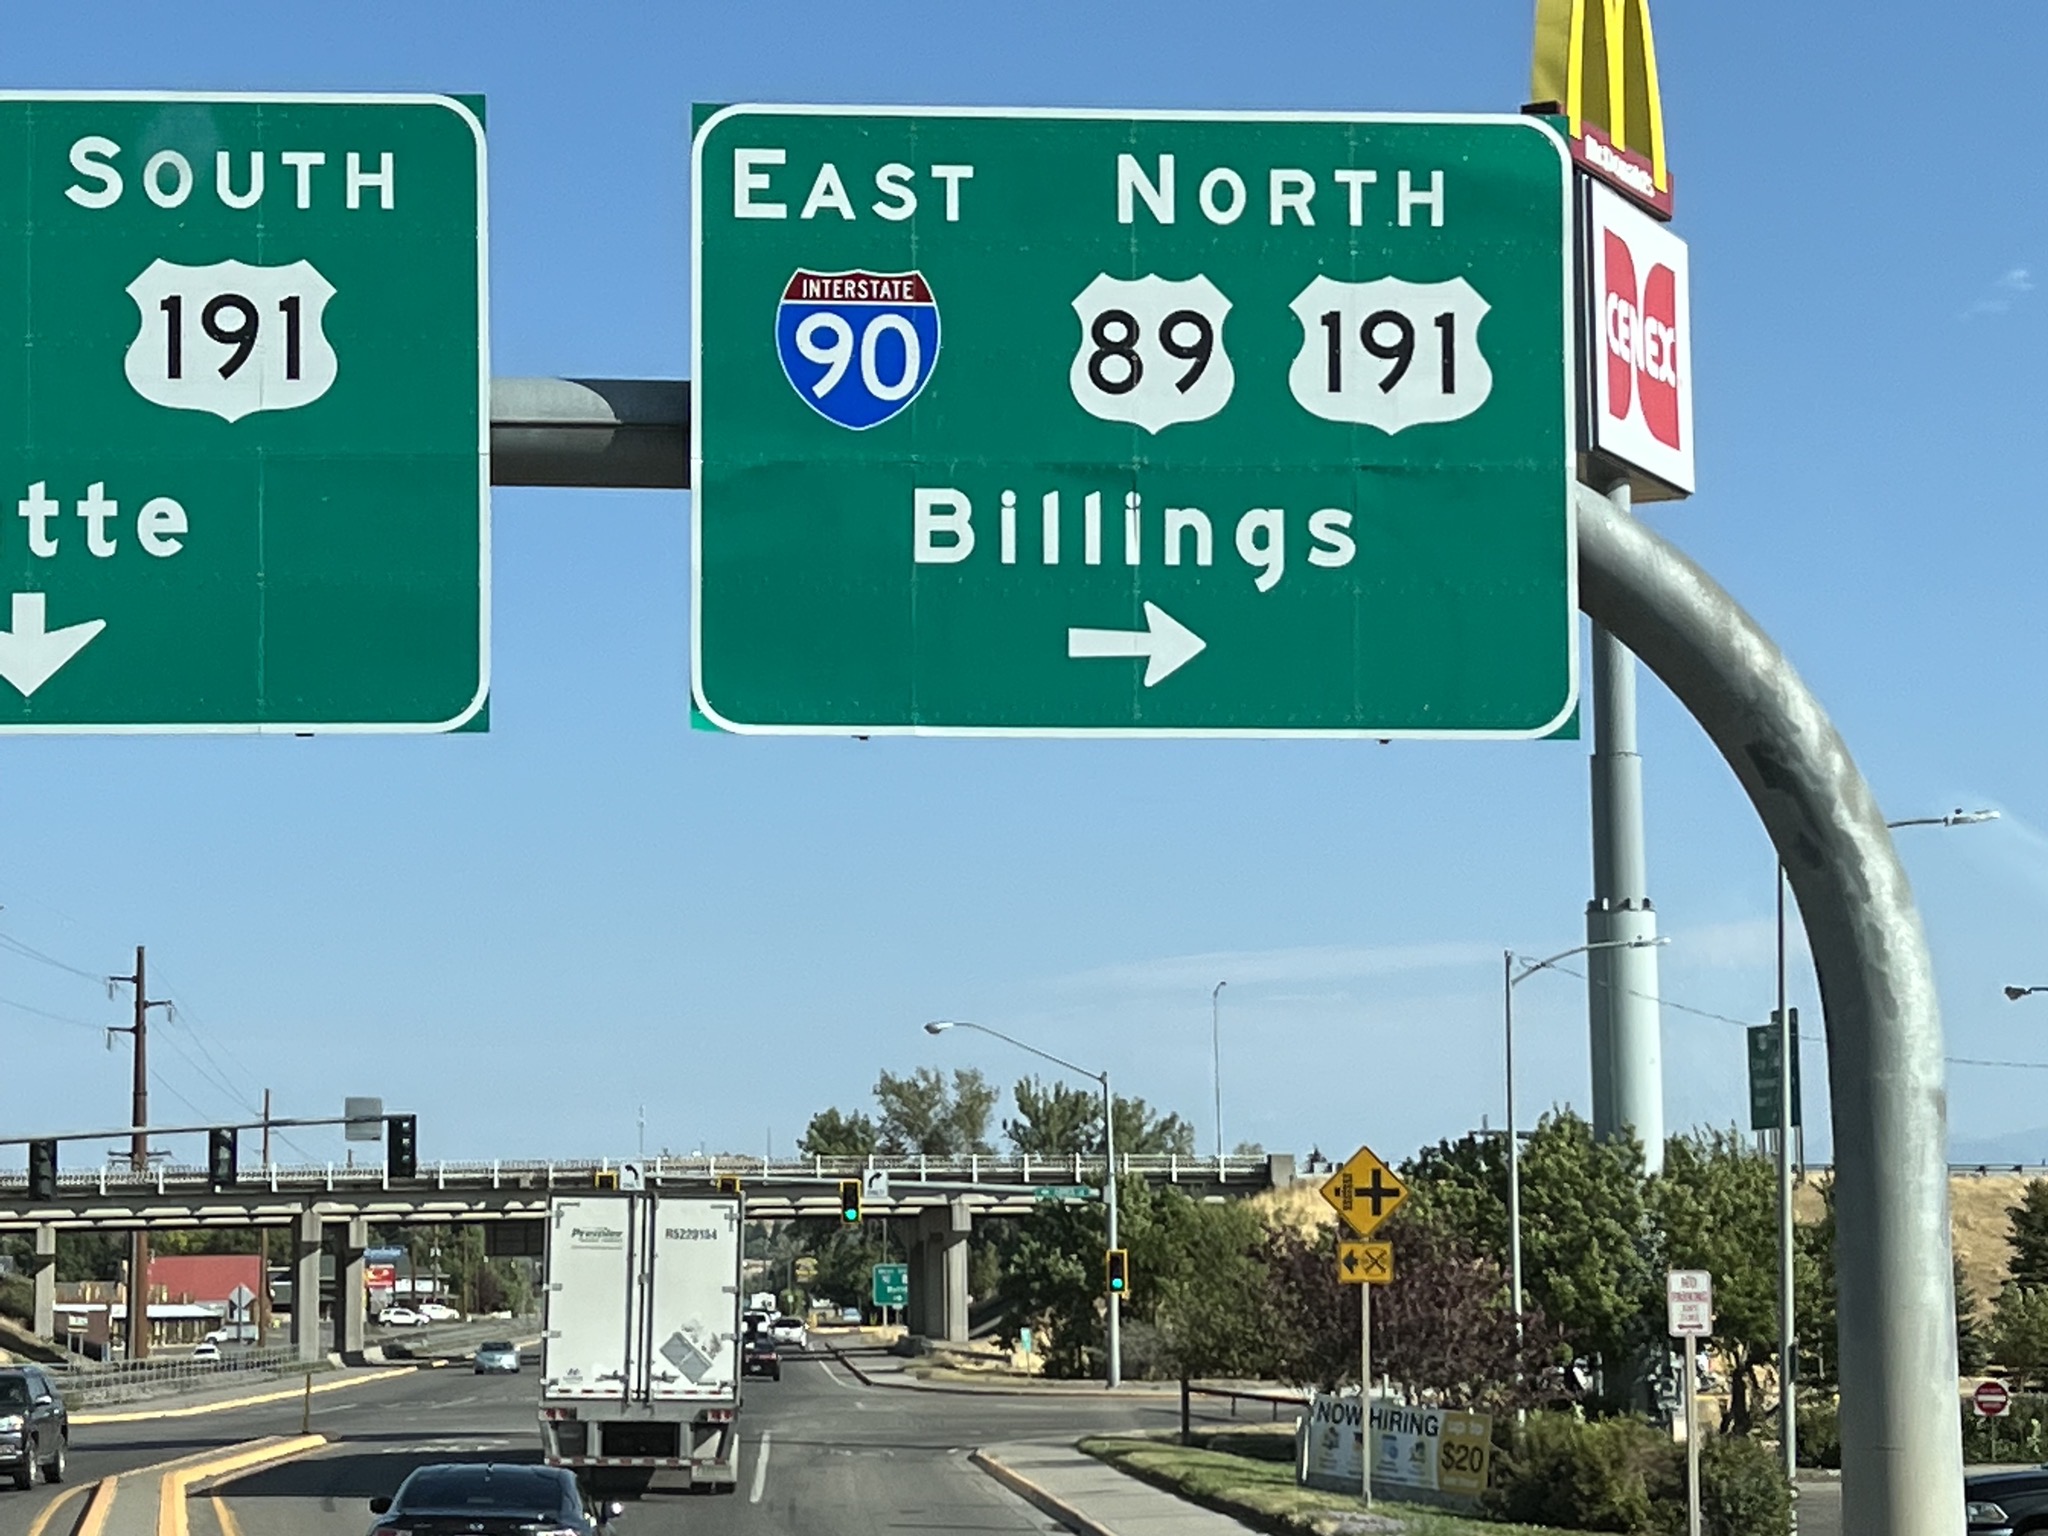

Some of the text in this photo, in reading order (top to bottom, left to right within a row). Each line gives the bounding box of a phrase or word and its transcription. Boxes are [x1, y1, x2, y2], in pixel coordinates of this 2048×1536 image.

[64, 135, 395, 210] SOUTH
[733, 147, 975, 222] EAST
[1116, 153, 1445, 228] NORTH
[802, 278, 915, 300] INTERSTATE
[159, 293, 301, 380] 191
[795, 311, 921, 402] 90
[1087, 309, 1214, 395] 89
[1320, 309, 1456, 395] 191
[1607, 290, 1678, 389] CENEX
[913, 487, 1357, 593] Billings
[1316, 1401, 1363, 1427] NOW
[1369, 1407, 1440, 1437] HIRING
[1442, 1441, 1484, 1474] $20
